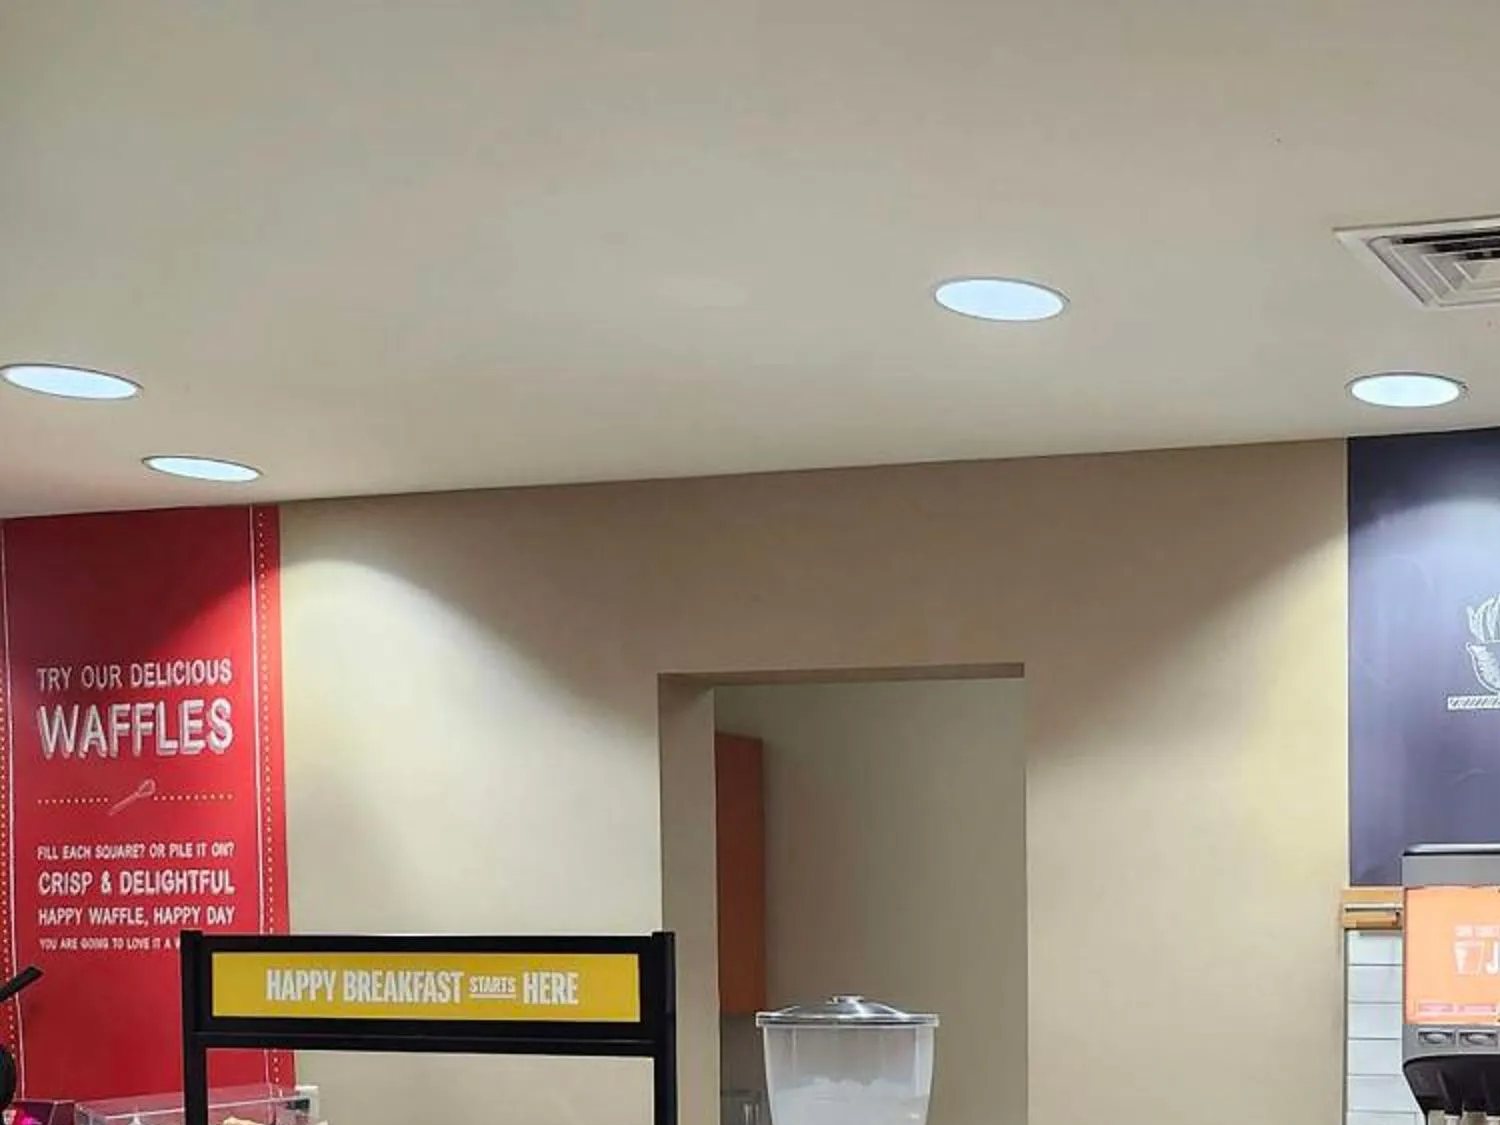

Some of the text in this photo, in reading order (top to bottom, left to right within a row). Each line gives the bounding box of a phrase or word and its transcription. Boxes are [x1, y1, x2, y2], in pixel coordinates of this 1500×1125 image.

[38, 658, 233, 691] TRY OUR DELICIOUS
[38, 698, 233, 757] WAFFLES
[38, 841, 235, 860] FILL EACH SQUARE? OR PILE IT ON?
[39, 869, 235, 895] CRISP & DELIGHTFUL
[38, 905, 235, 927] HAPPY WAFFLE, HAPPY DAY
[40, 938, 57, 950] YOU
[60, 938, 77, 950] ARE
[80, 938, 109, 950] GOING
[112, 937, 124, 950] TO
[126, 937, 149, 950] LOVE
[267, 969, 579, 1005] HAPPY BREAKFAST STARTS HERE
